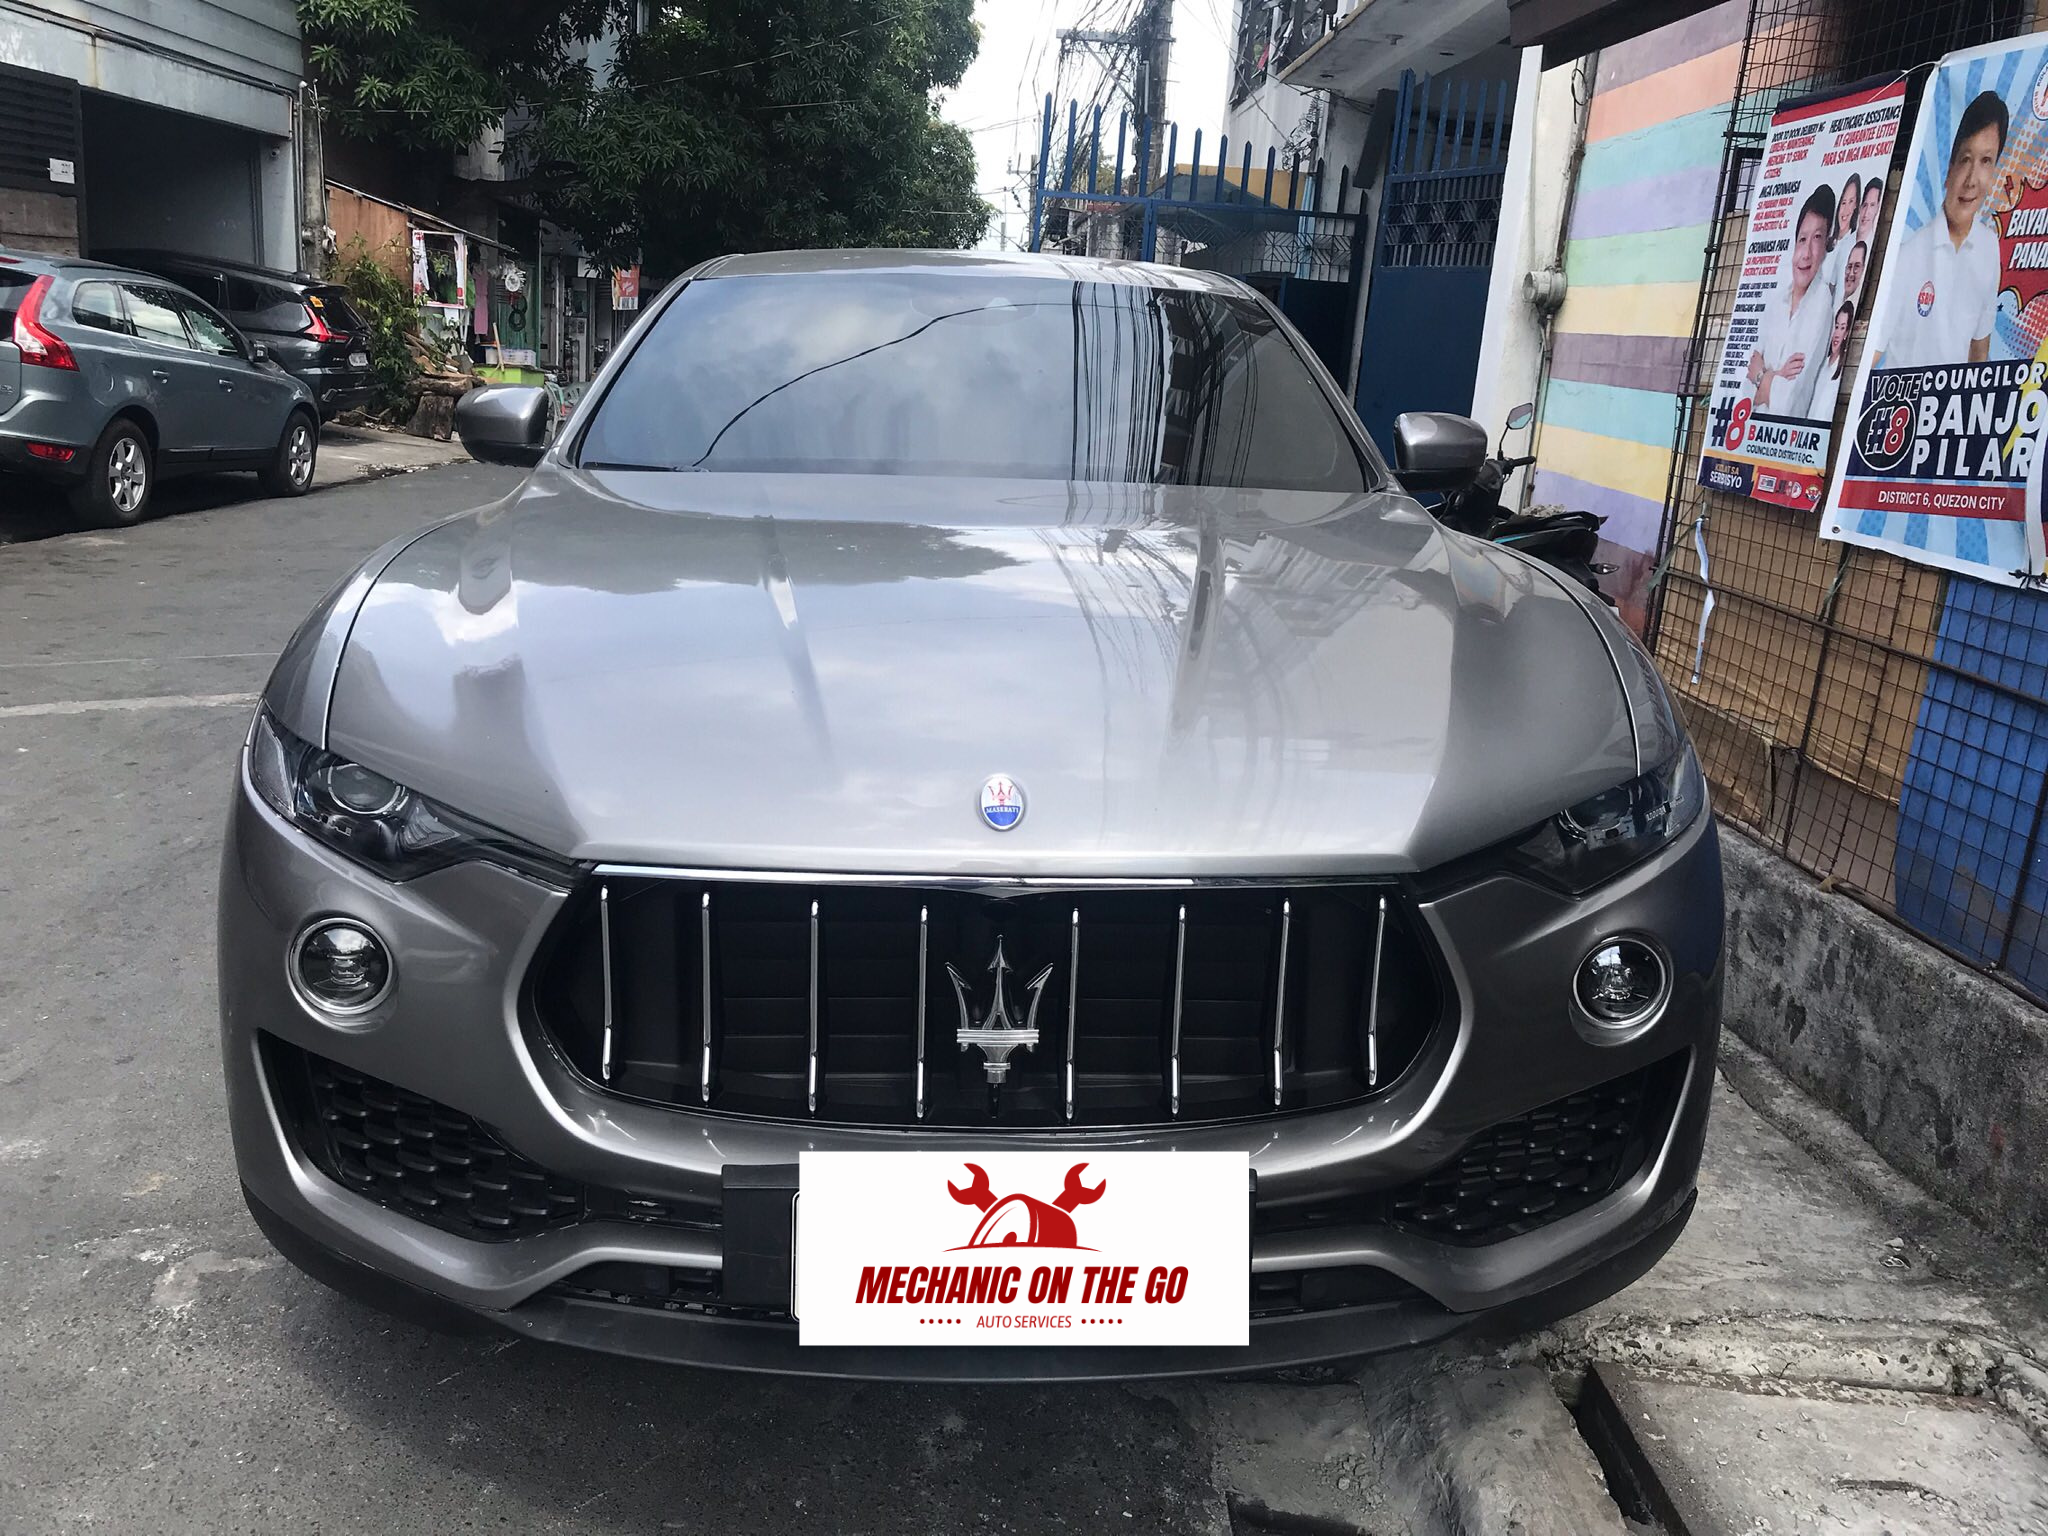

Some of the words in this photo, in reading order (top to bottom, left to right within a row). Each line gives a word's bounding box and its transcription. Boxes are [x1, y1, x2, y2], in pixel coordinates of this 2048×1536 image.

[1871, 373, 1924, 402] VOTE
[1922, 362, 2046, 391] COUNCILOR
[1710, 396, 1752, 451] #8
[1865, 405, 1911, 456] #8
[1916, 389, 2048, 437] BANJO
[1747, 425, 1788, 445] BANJO
[1790, 429, 1821, 451] PILAR
[1910, 437, 2036, 477] PILAR
[1710, 470, 1742, 488] SERBISYO
[1878, 490, 1921, 505] DISTRICT
[1922, 492, 1931, 508] 6,
[1933, 493, 1979, 510] QUEZON
[1979, 496, 2005, 511] CITY
[986, 806, 1019, 814] MASERATI
